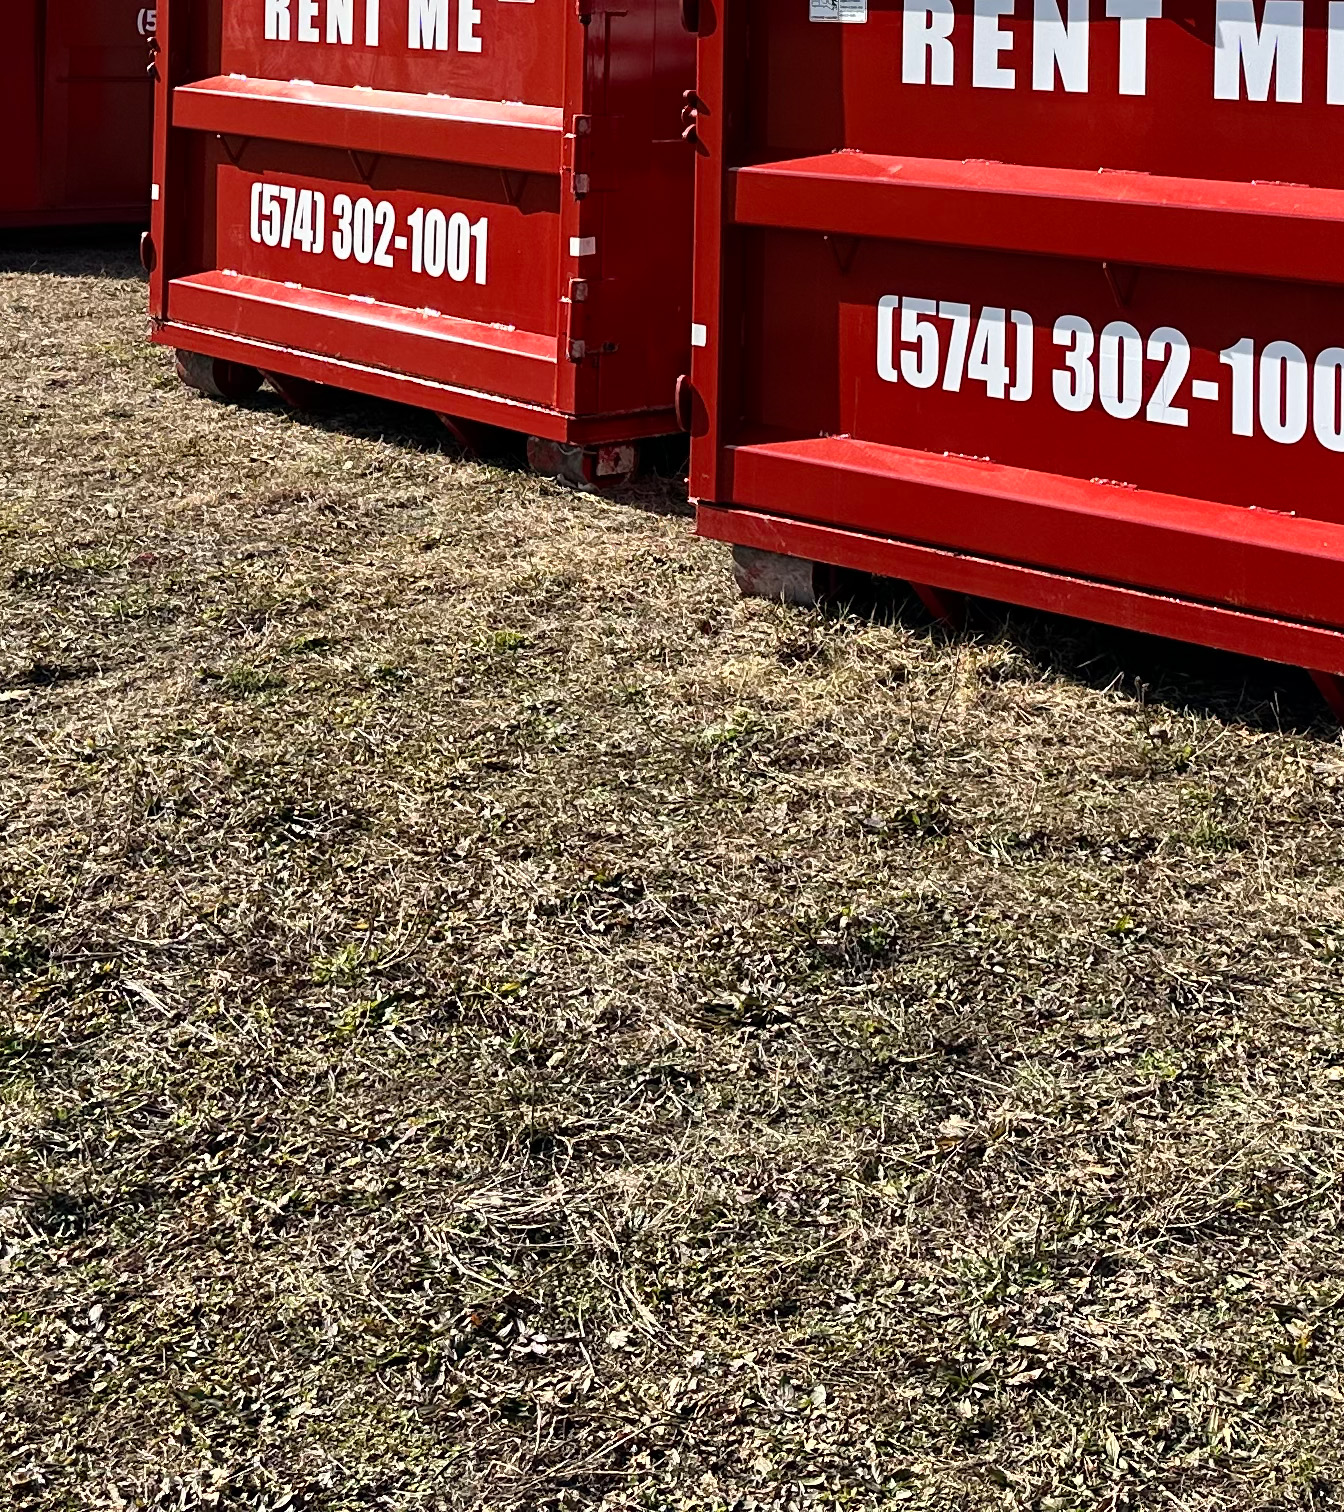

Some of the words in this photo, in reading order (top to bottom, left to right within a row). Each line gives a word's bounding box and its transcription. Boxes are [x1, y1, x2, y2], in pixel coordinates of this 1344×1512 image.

[250, 182, 325, 254] (574)
[332, 193, 488, 285] 302-1001
[876, 294, 1034, 402] (574)
